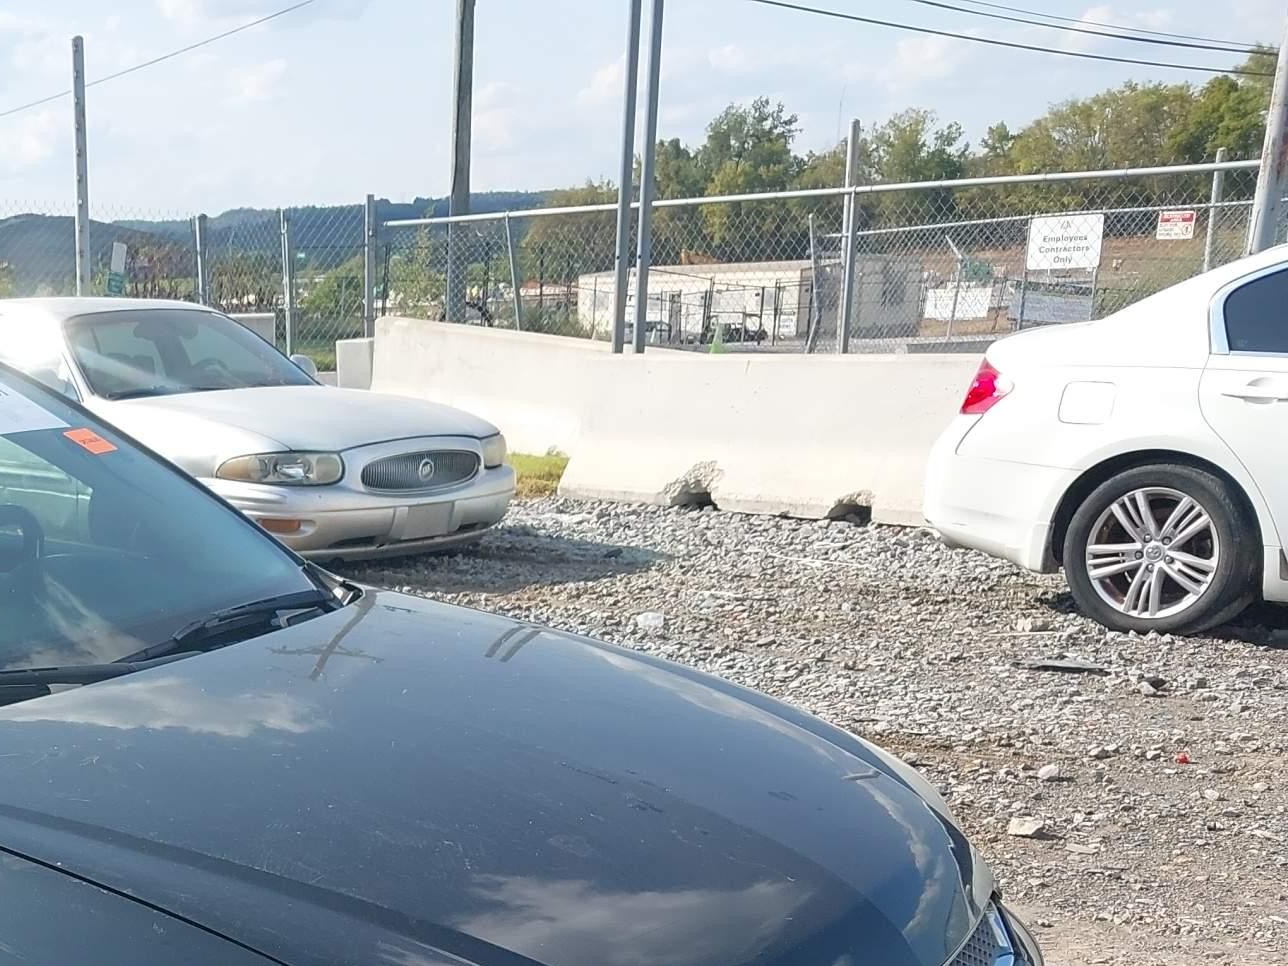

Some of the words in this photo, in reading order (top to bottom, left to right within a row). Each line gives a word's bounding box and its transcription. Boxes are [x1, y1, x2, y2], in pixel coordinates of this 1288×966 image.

[1042, 234, 1088, 243] Employees
[1039, 245, 1090, 254] Contractors
[1053, 255, 1073, 264] Only
